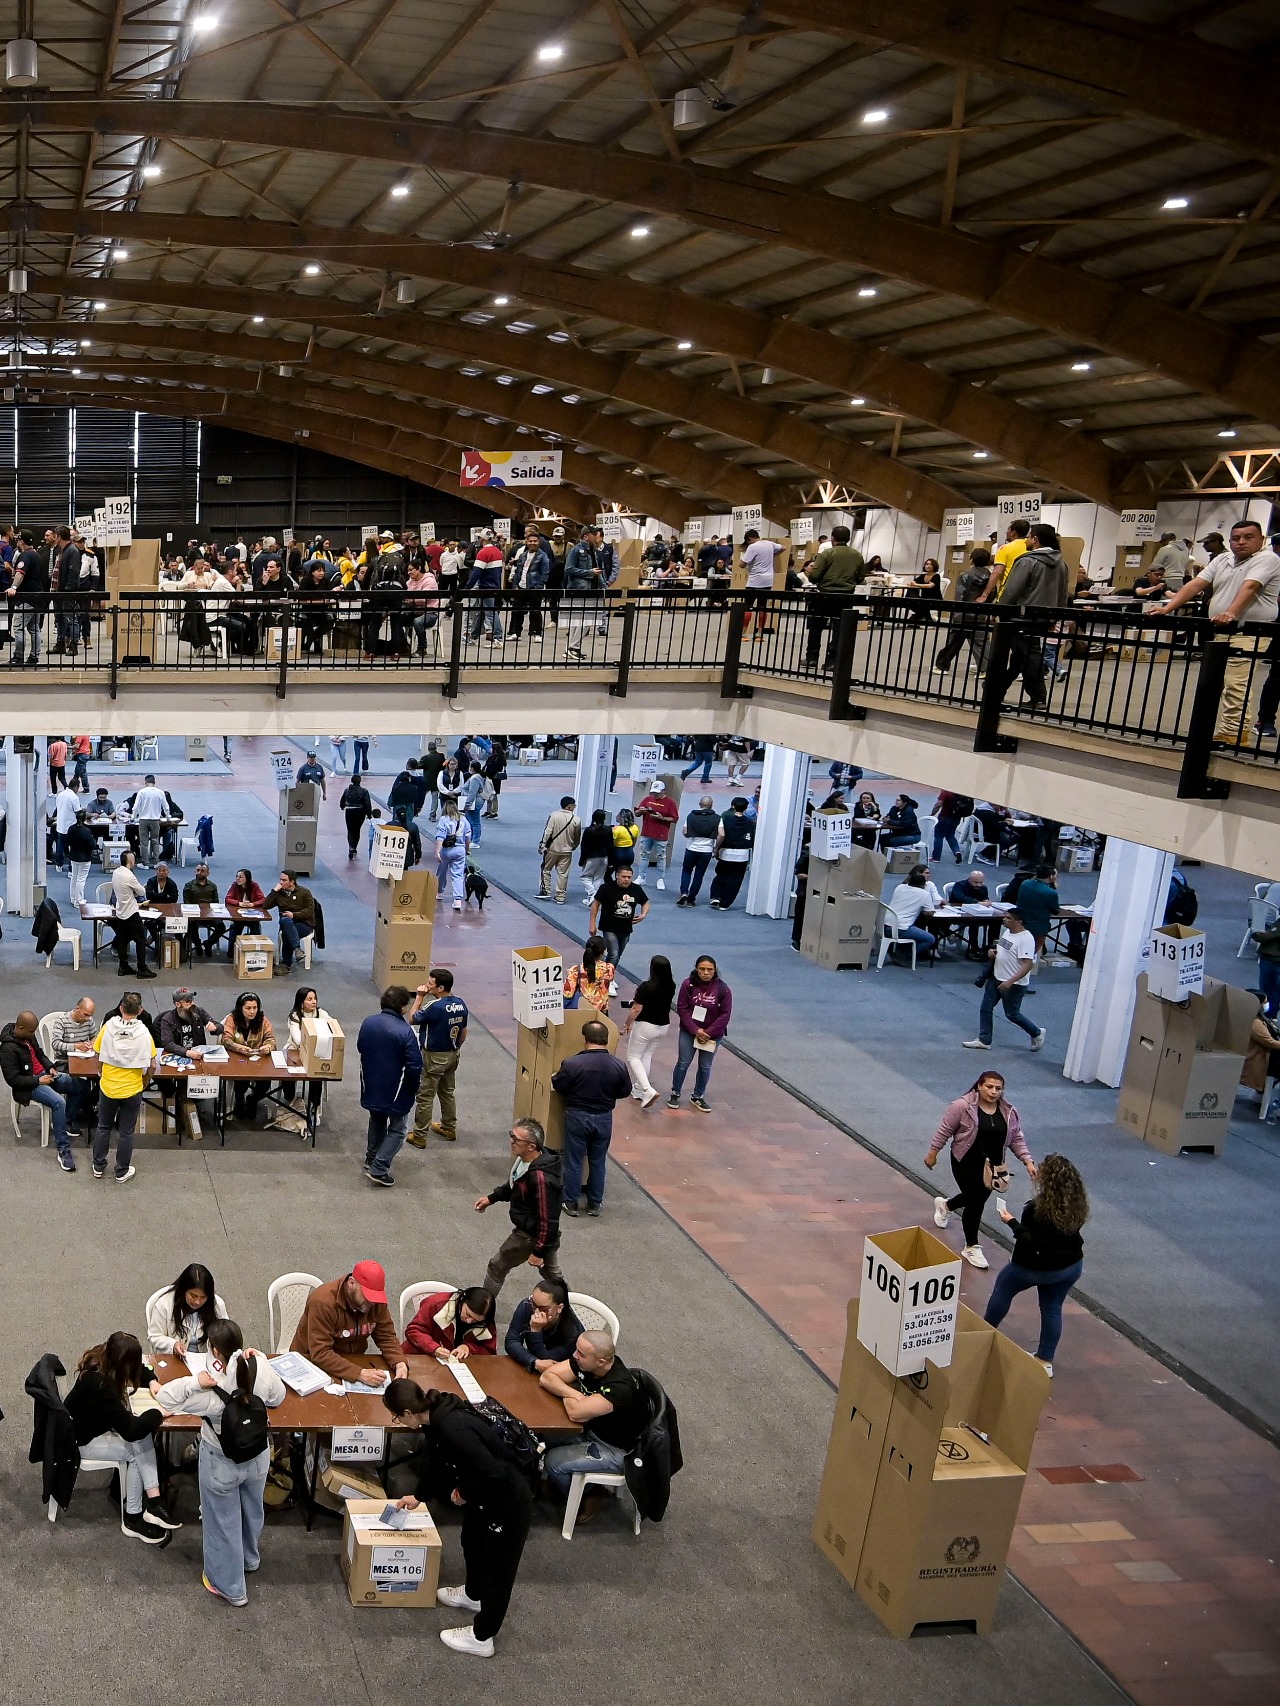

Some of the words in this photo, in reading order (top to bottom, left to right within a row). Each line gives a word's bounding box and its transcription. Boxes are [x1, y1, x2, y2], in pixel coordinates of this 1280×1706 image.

[511, 466, 554, 478] Salida
[109, 502, 129, 515] 192
[999, 502, 1013, 513] 193
[1018, 499, 1040, 512] 193
[605, 516, 619, 524] 205
[733, 511, 742, 520] 199
[744, 509, 760, 519] 199
[1122, 514, 1135, 522] 200
[1138, 514, 1155, 523] 200
[78, 520, 91, 528] 204
[642, 751, 657, 760] 125
[275, 758, 292, 767] 124
[813, 817, 827, 830] 119
[830, 819, 851, 831] 119
[383, 835, 405, 849] 118
[1152, 939, 1177, 961] 113
[1181, 942, 1204, 960] 113
[513, 961, 527, 984] 112
[532, 965, 562, 984] 112
[866, 1255, 900, 1303] 106
[908, 1275, 956, 1307] 106
[904, 1313, 953, 1331] 53.047.539
[902, 1333, 950, 1350] 53.056.298
[335, 1446, 359, 1454] MESA
[362, 1446, 380, 1454] 106
[373, 1566, 399, 1574] MESA
[402, 1566, 422, 1574] 106
[919, 1564, 996, 1575] REGISTRADURÍA
